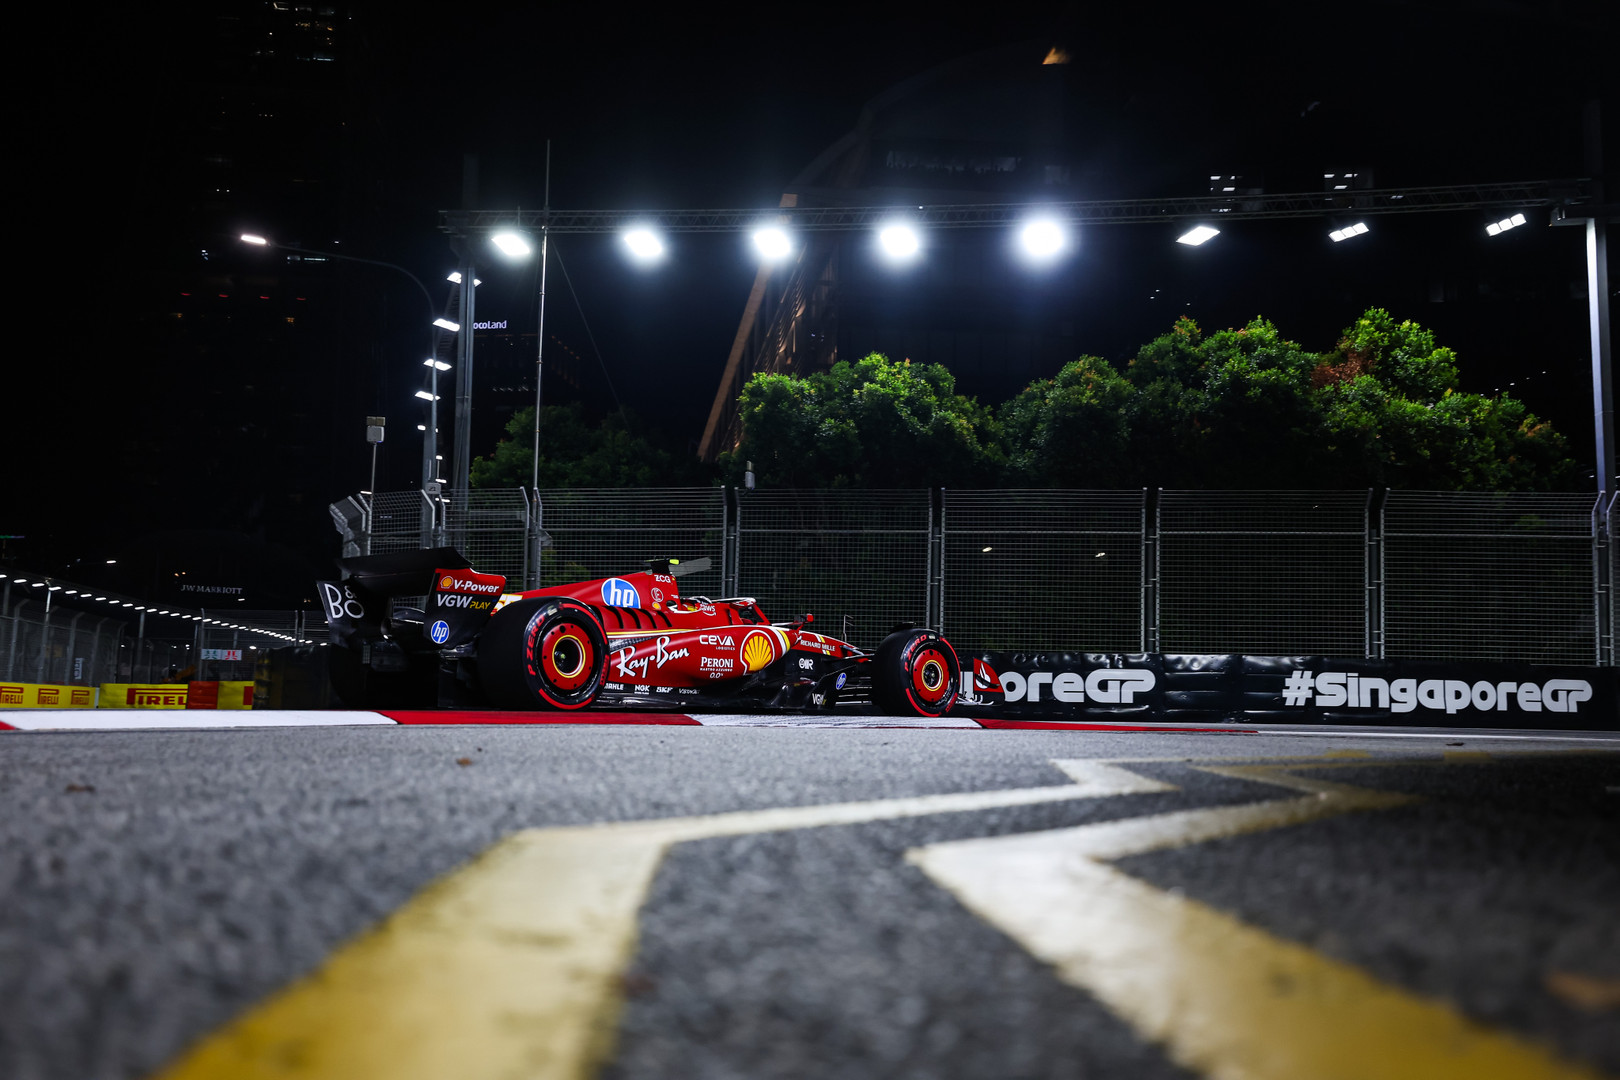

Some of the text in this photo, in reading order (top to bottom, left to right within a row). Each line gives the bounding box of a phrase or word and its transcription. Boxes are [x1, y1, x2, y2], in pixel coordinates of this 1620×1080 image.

[197, 586, 244, 595] MARRIOTT
[453, 579, 500, 593] V-Power
[609, 579, 635, 608] hp
[437, 593, 473, 609] VGW
[470, 601, 491, 611] PLAY
[432, 621, 448, 643] hp
[526, 614, 546, 661] ZERO
[800, 639, 836, 651] RICHARD MILLE
[700, 656, 734, 668] PERONI
[37, 688, 60, 705] PIRELLI
[1281, 670, 1594, 715] #SingaporeGP
